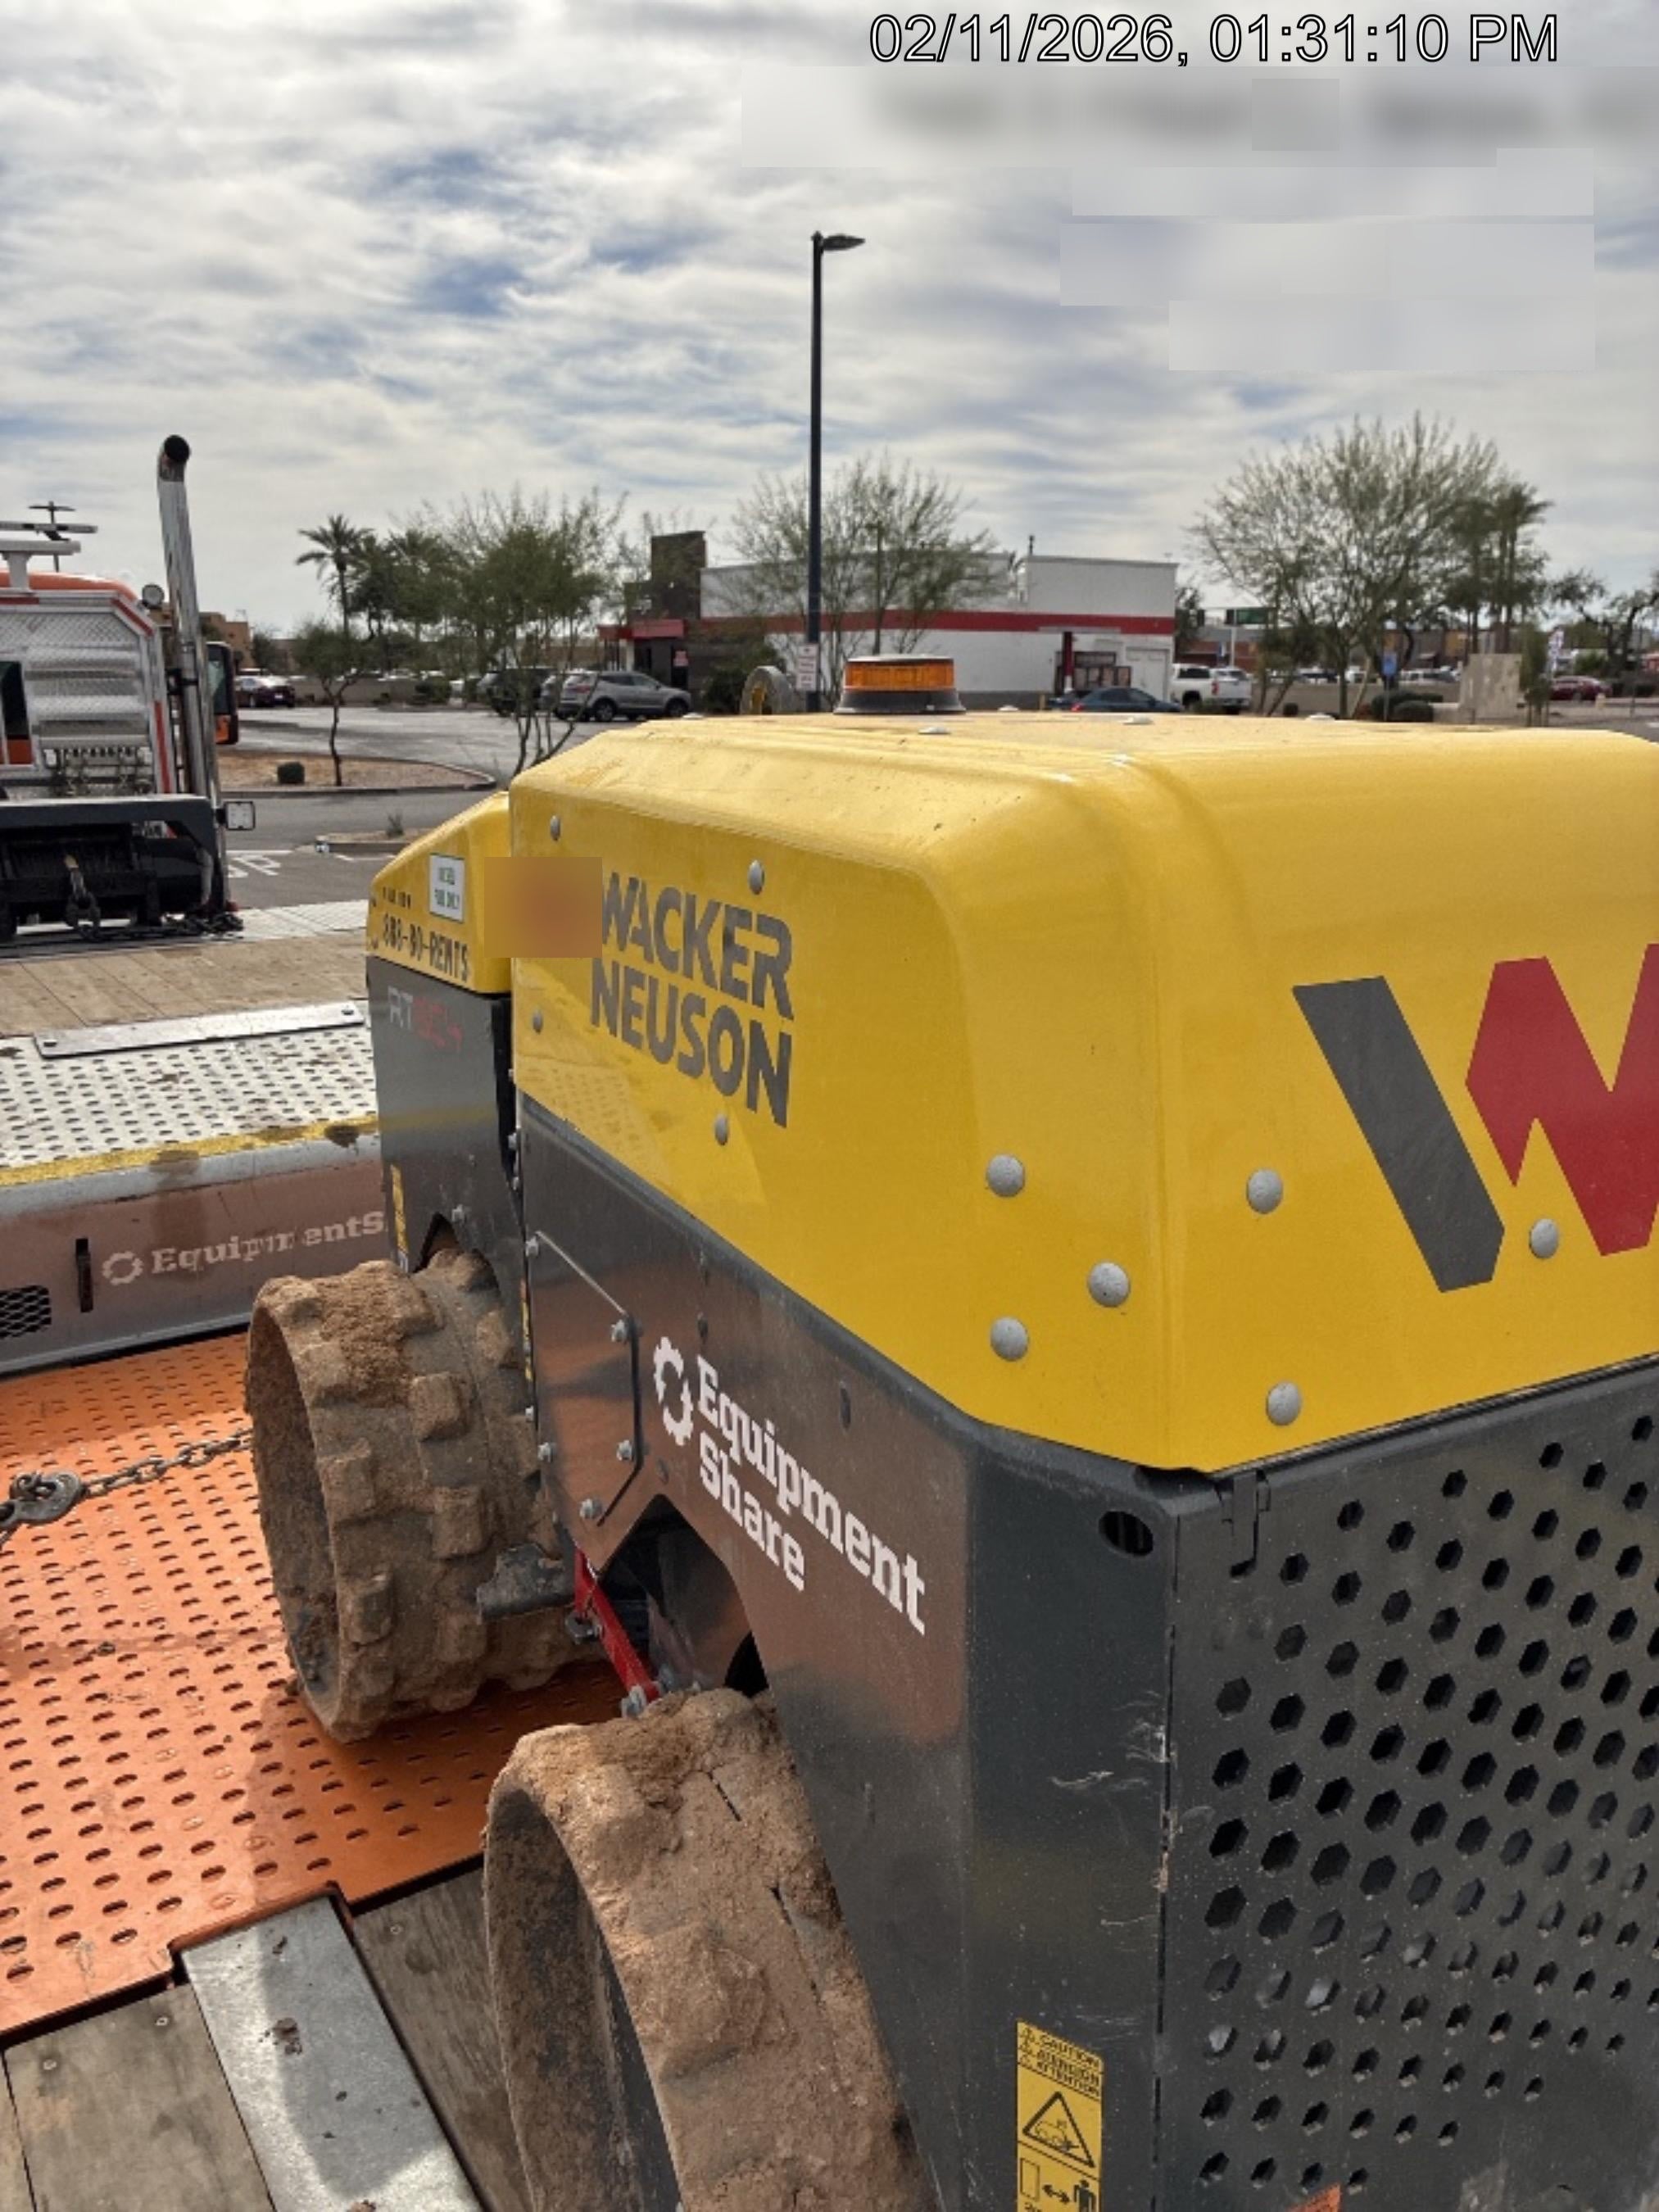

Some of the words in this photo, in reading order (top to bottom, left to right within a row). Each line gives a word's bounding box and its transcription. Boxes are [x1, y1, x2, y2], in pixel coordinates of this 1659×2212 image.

[602, 871, 794, 1021] WACKER
[592, 957, 792, 1128] NEUSON
[696, 1354, 925, 1636] Equipment
[699, 1431, 805, 1592] Share
